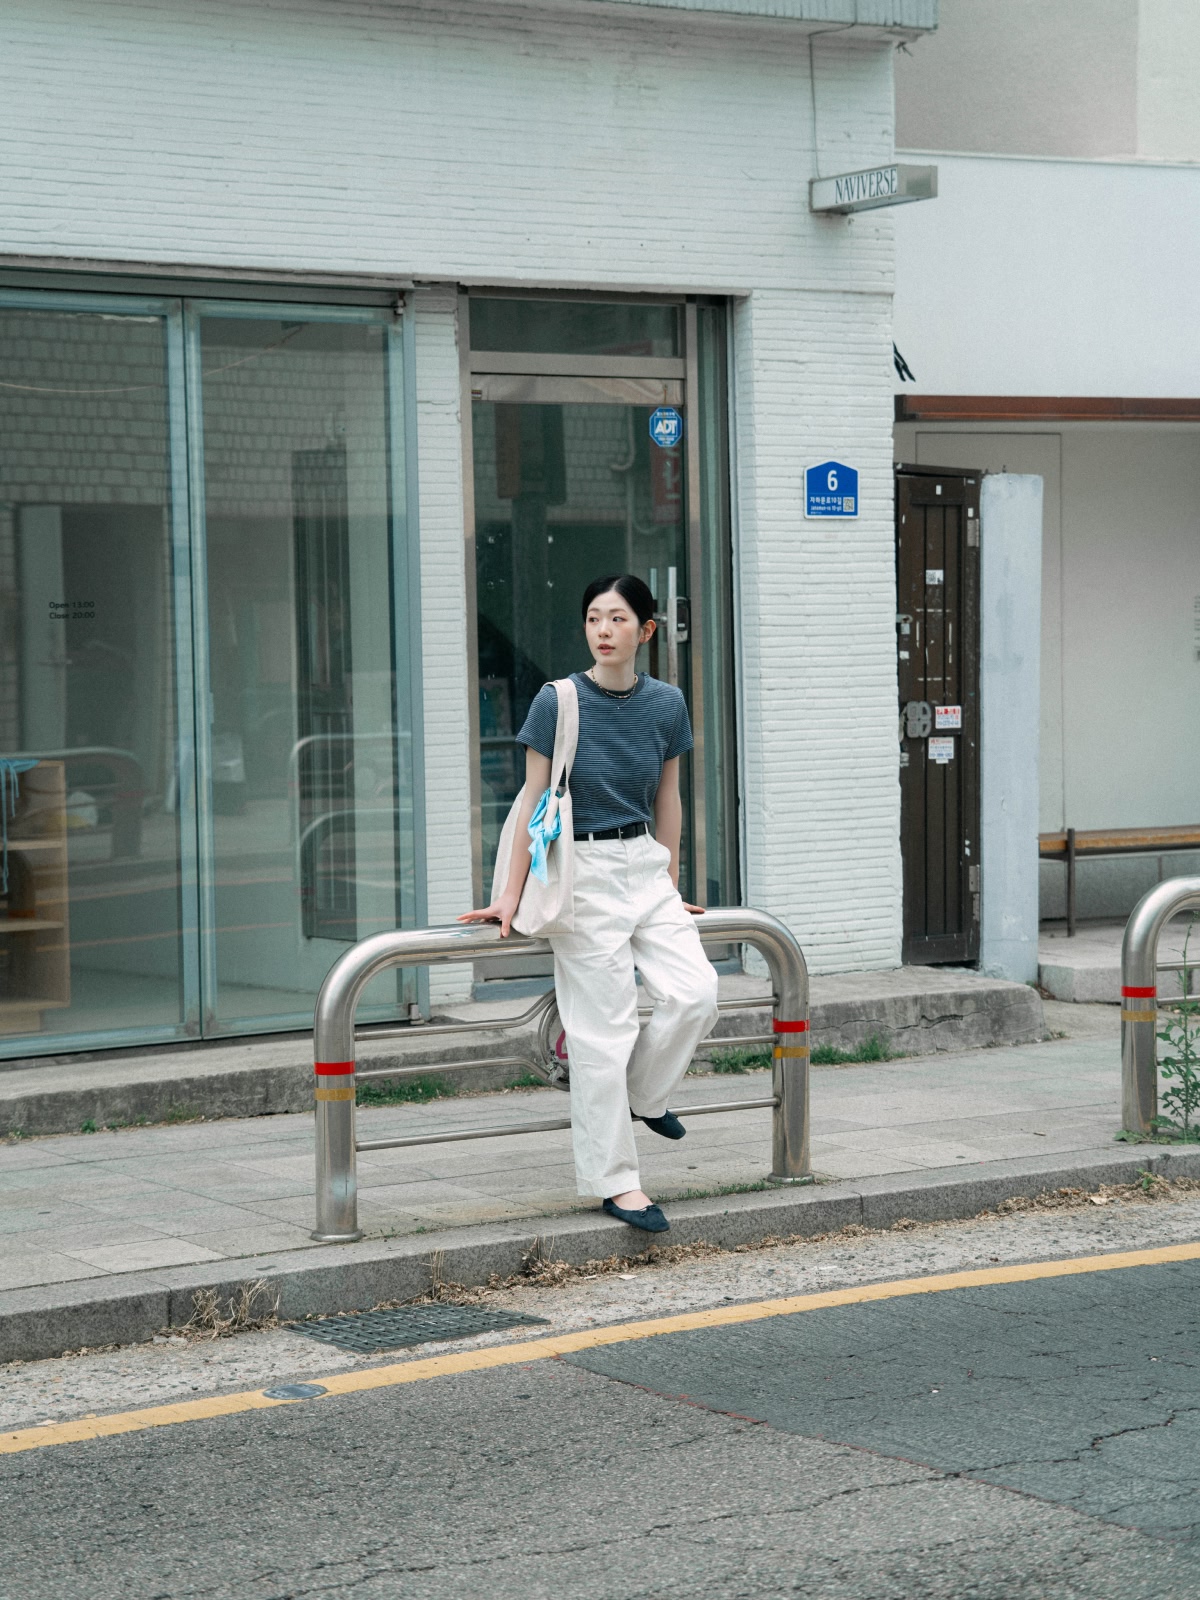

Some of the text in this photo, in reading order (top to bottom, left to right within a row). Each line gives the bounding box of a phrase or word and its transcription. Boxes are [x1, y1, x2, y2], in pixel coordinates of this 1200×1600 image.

[835, 168, 897, 204] NAVIVERSE
[655, 420, 677, 434] ADT
[827, 470, 838, 491] 6
[49, 601, 70, 610] Open
[49, 612, 70, 620] Close
